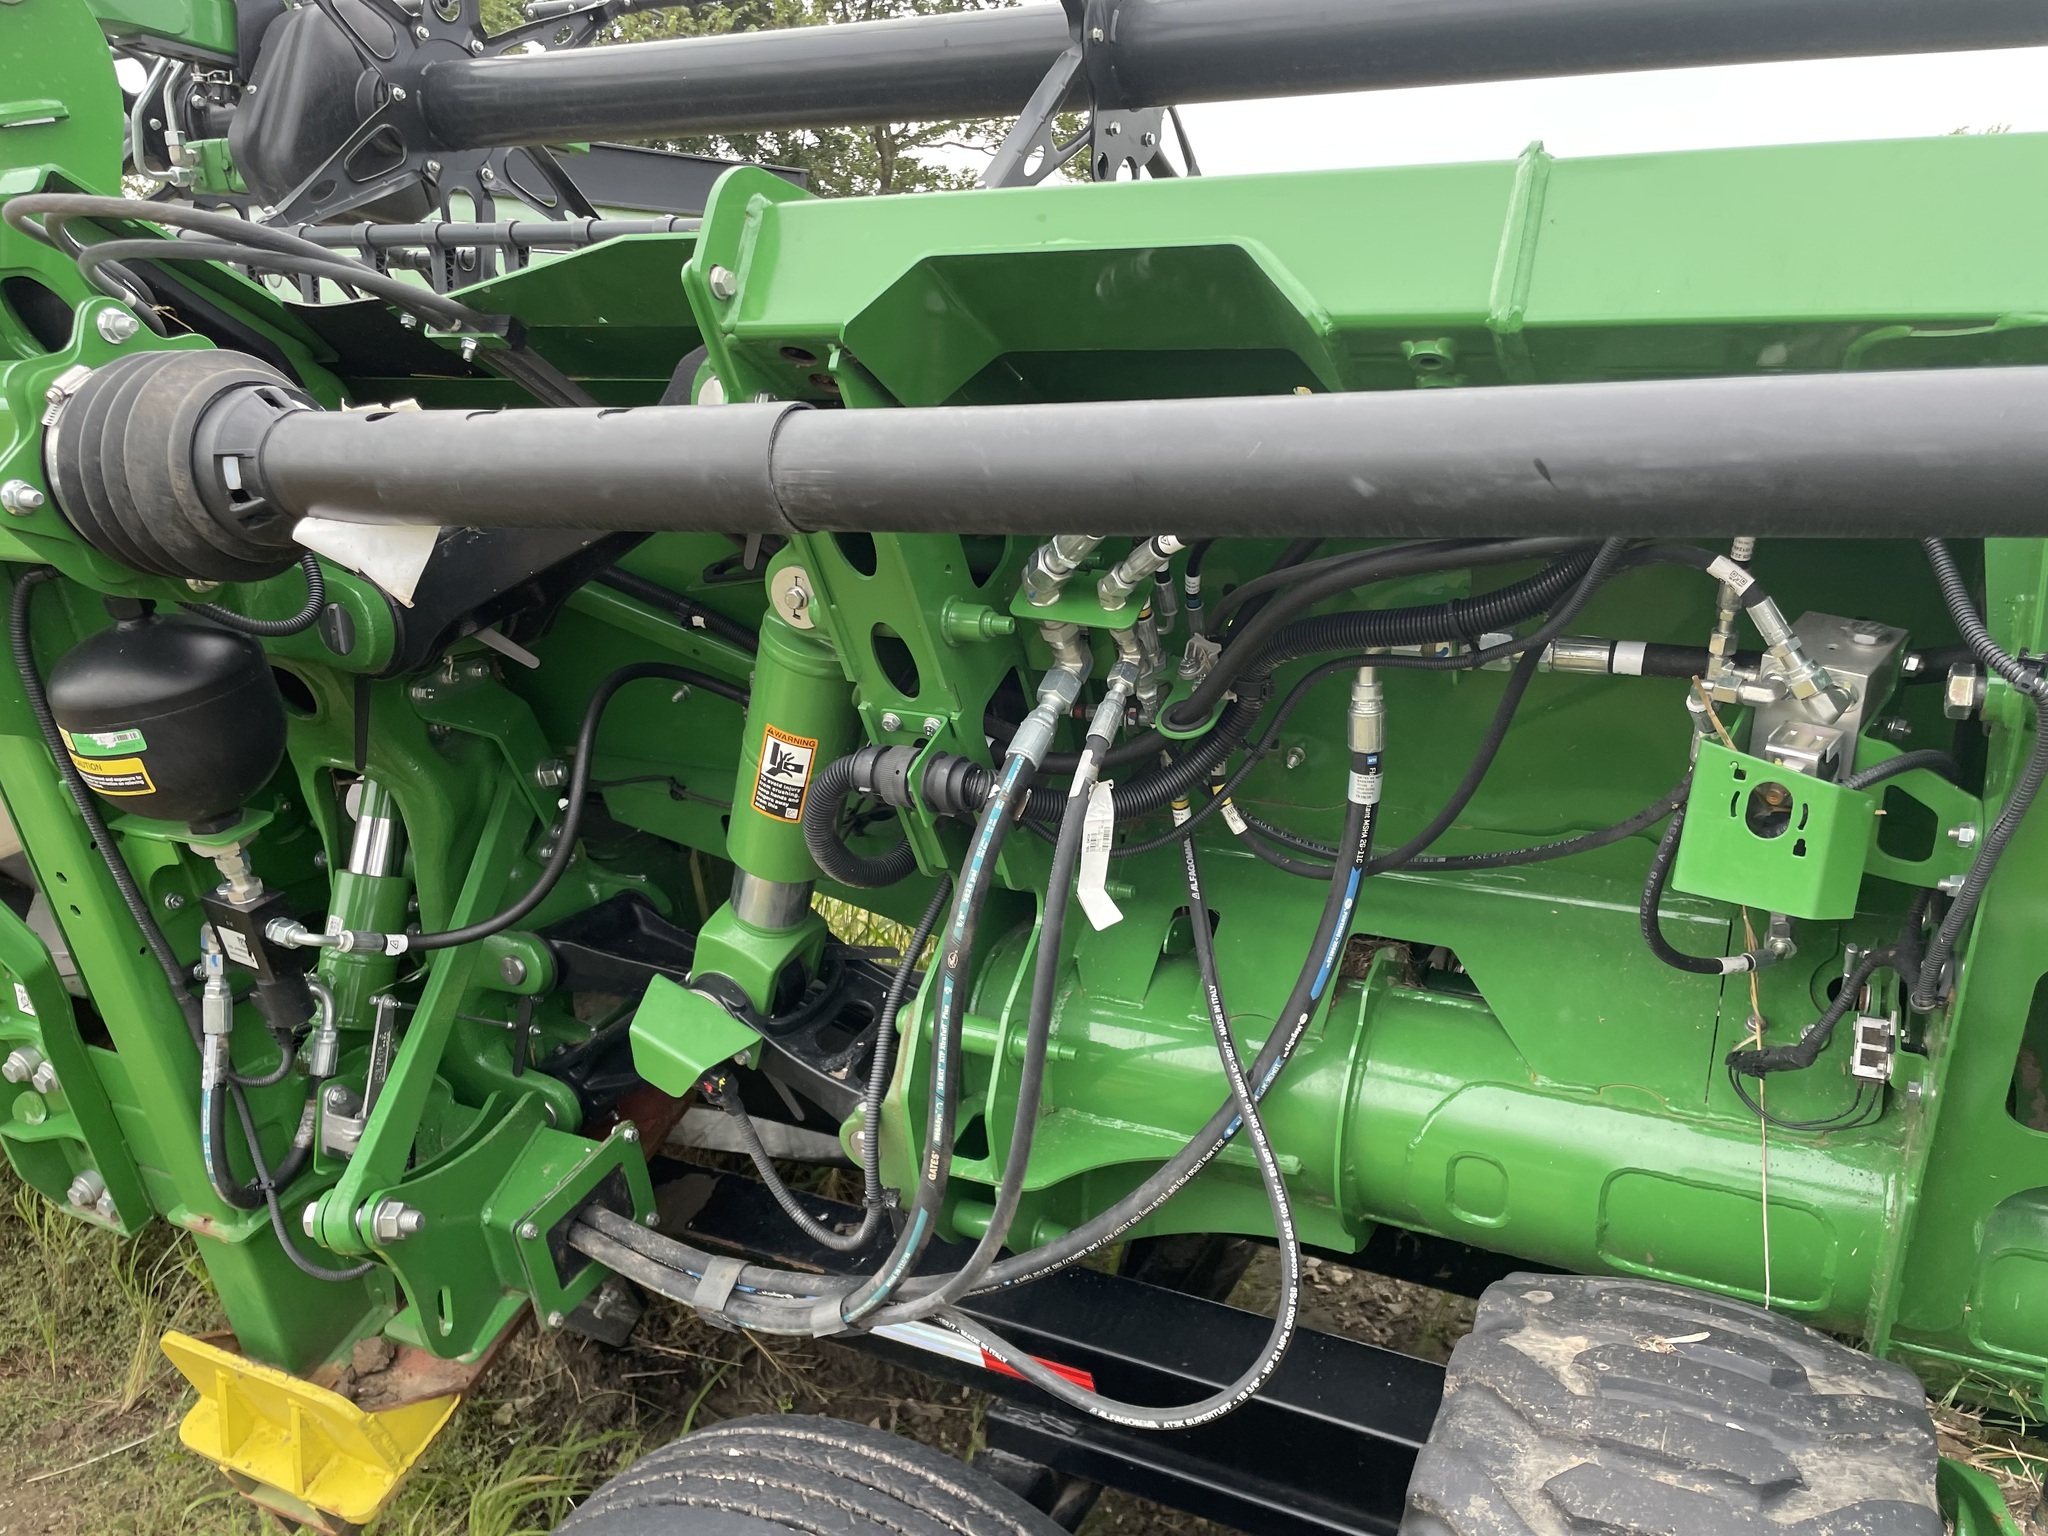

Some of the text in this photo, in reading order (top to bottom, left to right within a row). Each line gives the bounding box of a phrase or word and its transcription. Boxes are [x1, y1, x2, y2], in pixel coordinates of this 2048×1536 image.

[774, 730, 816, 748] WARNING
[767, 779, 782, 788] avoid
[783, 785, 802, 793] injury
[1359, 819, 1371, 838] MSHA
[1182, 837, 1199, 892] ALFAGOMMA
[966, 868, 979, 883] psi
[961, 882, 973, 903] 3625
[1208, 983, 1219, 1004] ITALY
[1212, 1003, 1221, 1013] IN
[1215, 1013, 1227, 1036] MADE
[1222, 1040, 1239, 1073] IC-152/7
[1232, 1073, 1248, 1098] MSHA
[1244, 1102, 1254, 1114] 10
[1248, 1113, 1260, 1128] DN
[1211, 1137, 1225, 1151] 22.5
[1253, 1128, 1267, 1146] 1SC
[1201, 1149, 1214, 1163] MPa
[1267, 1163, 1277, 1177] EN
[1274, 1184, 1284, 1201] R17
[1279, 1202, 1289, 1218] 100
[1283, 1220, 1293, 1239] SAE
[1287, 1241, 1297, 1278] exceeds
[959, 1329, 981, 1345] MADE
[987, 1347, 1008, 1363] ITALY
[1276, 1330, 1289, 1350] MPa
[1271, 1350, 1281, 1361] 21
[1261, 1359, 1275, 1375] WP
[1184, 1400, 1233, 1426] SUPERTUFF
[1163, 1420, 1185, 1428] AT3K
